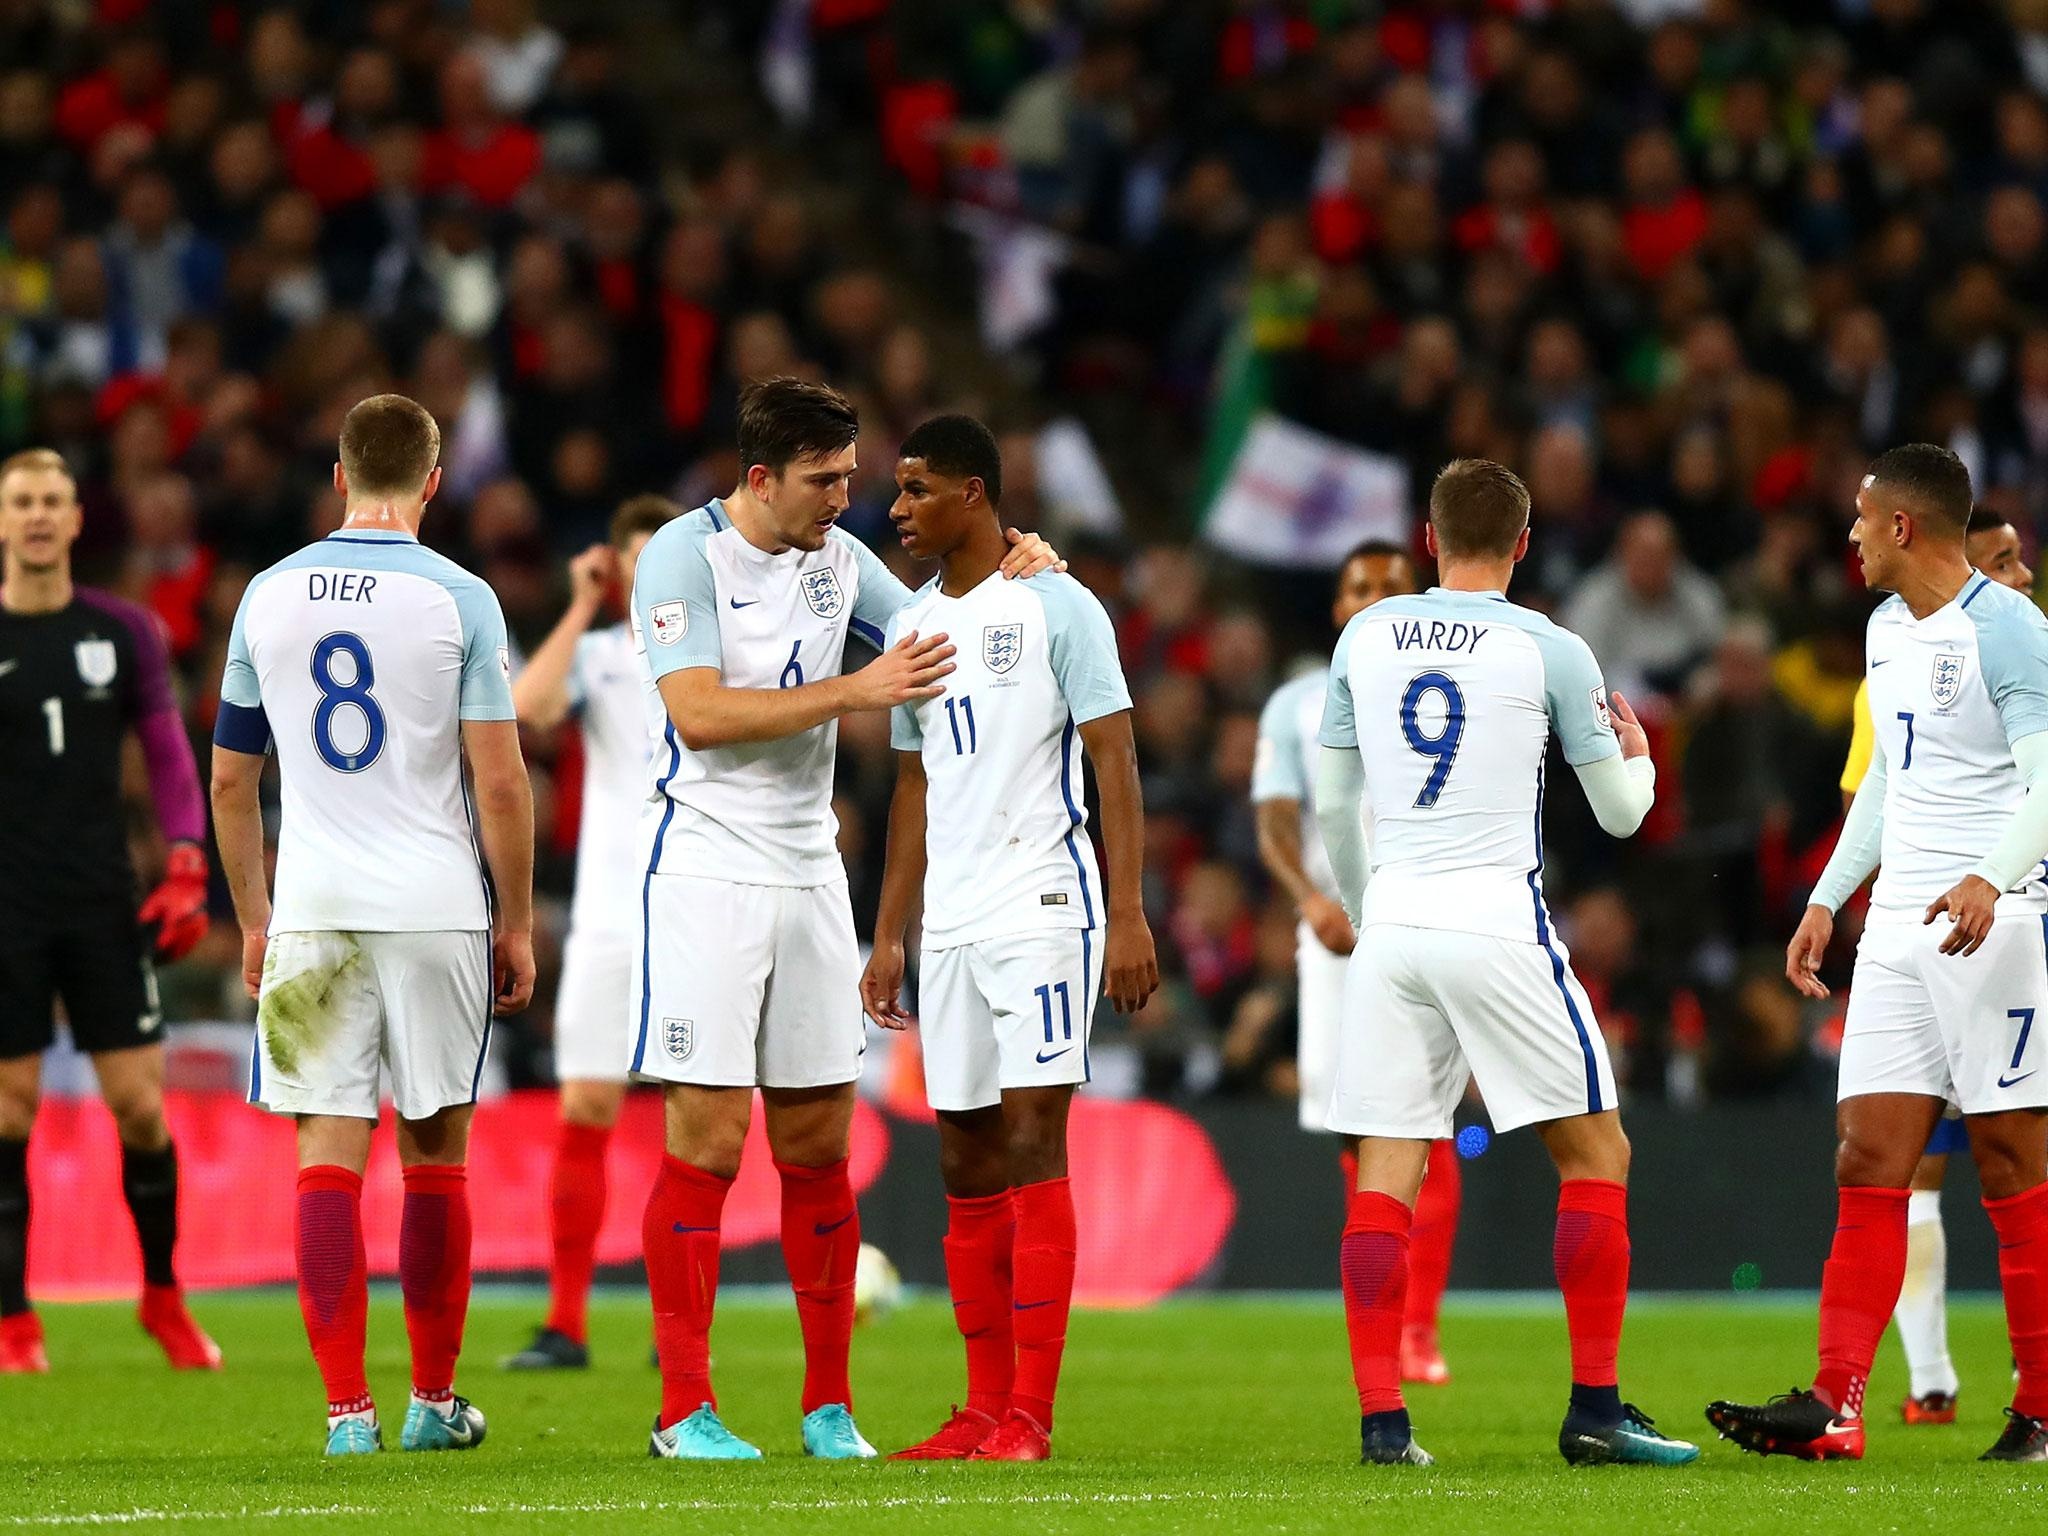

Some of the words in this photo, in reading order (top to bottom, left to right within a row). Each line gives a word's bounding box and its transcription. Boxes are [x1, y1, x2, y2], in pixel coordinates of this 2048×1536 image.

[309, 573, 377, 603] DIER
[780, 639, 804, 689] 6
[1392, 621, 1489, 654] VARDY
[42, 696, 65, 756] 1
[310, 630, 388, 775] 8
[944, 694, 977, 756] 11
[1399, 669, 1467, 809] 9
[1896, 711, 1915, 770] 7
[1034, 980, 1072, 1043] 11
[2007, 1007, 2036, 1069] 7
